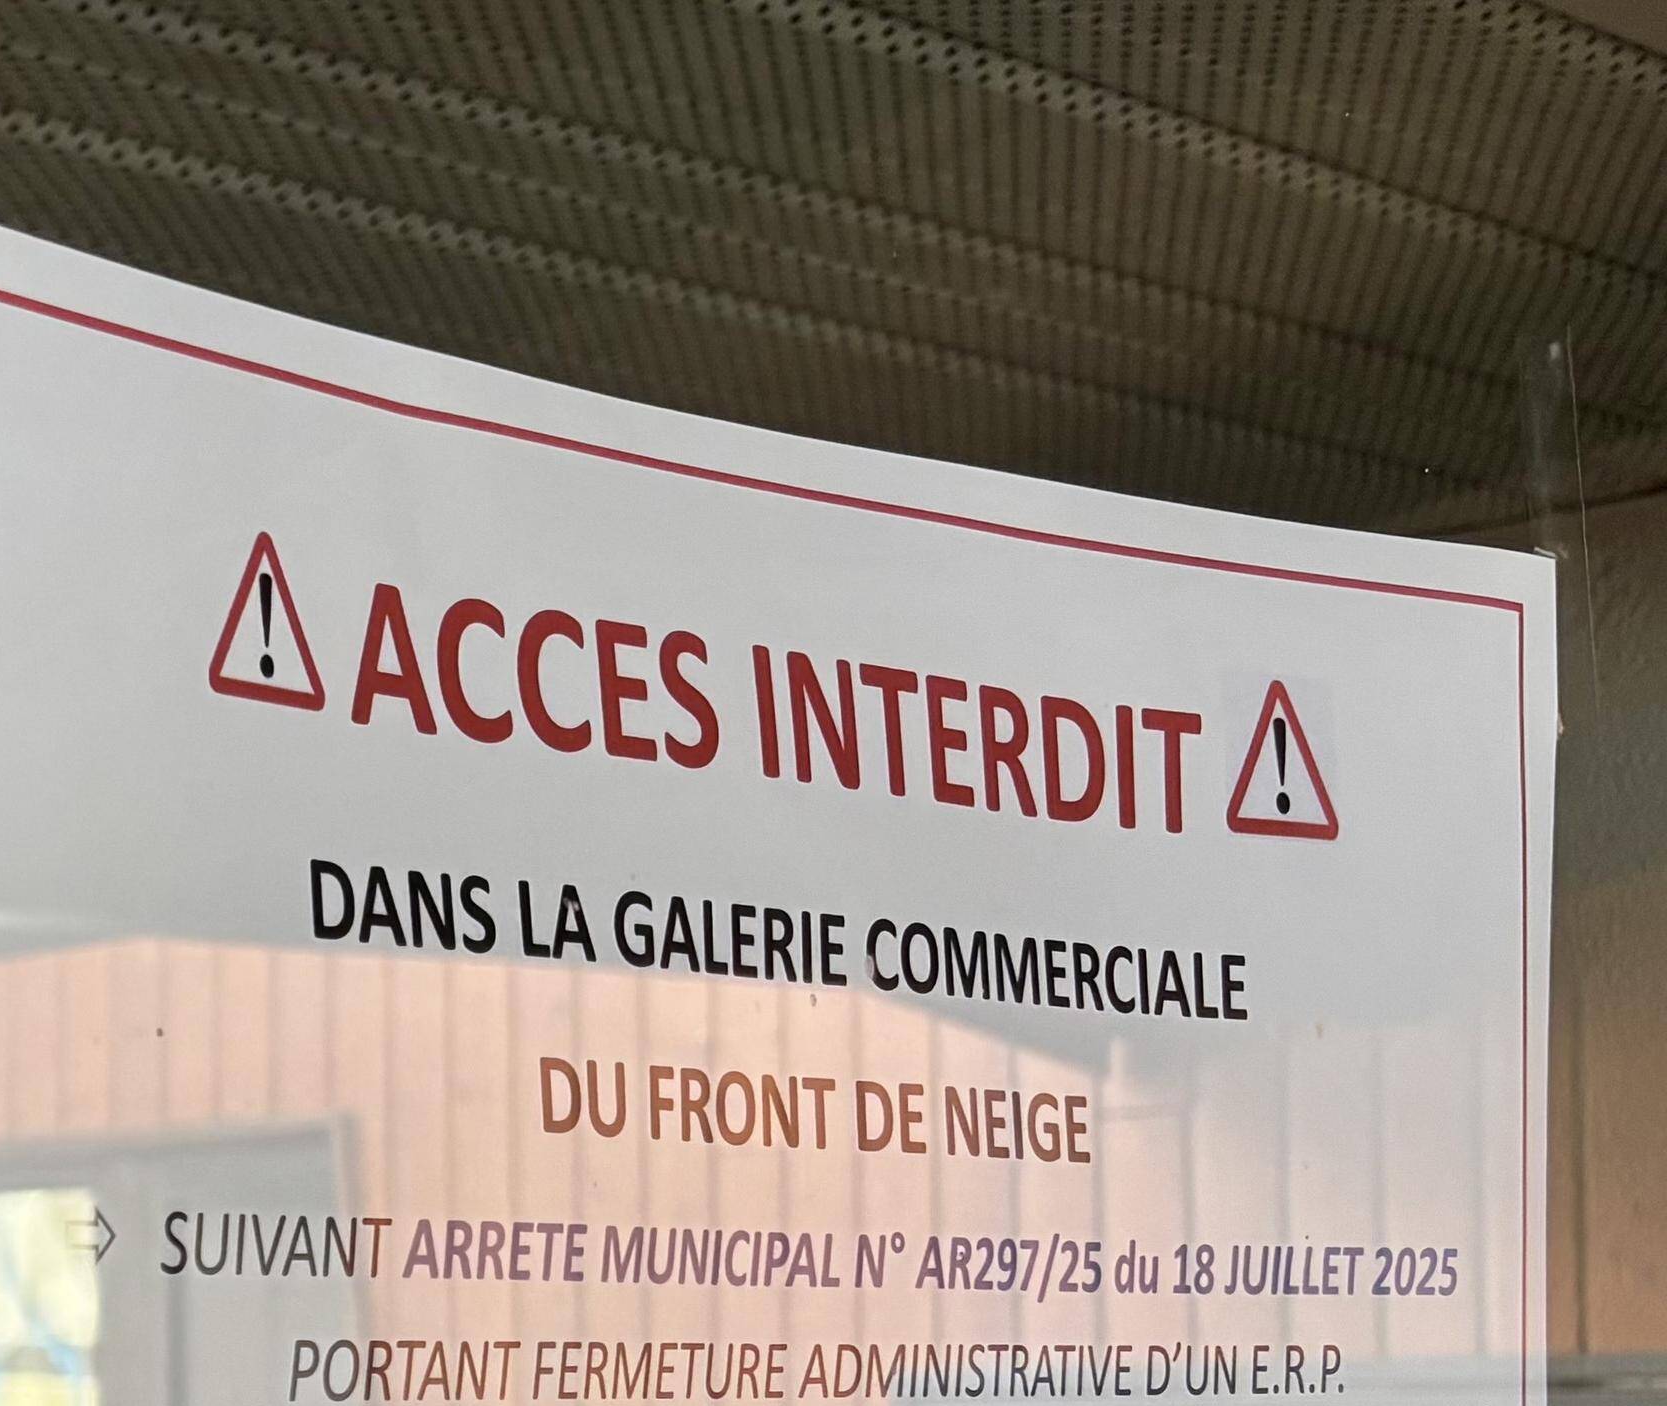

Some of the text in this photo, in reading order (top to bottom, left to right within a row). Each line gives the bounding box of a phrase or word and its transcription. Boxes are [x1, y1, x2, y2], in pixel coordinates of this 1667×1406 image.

[351, 582, 1202, 834] ACCES INTERDIT
[309, 858, 1249, 1021] DANS LA GALERIE COMMERCIALE
[539, 1056, 1092, 1165] DU FRONT DE NEIGE
[160, 1211, 1459, 1303] SUIVANT ARRETE MUNICIPAL N° AR297/25 du 18 JUILLET 2025
[289, 1339, 1345, 1402] PORTANT FERMETURE ADMINISTRATIVE D’UN E.R.P.
